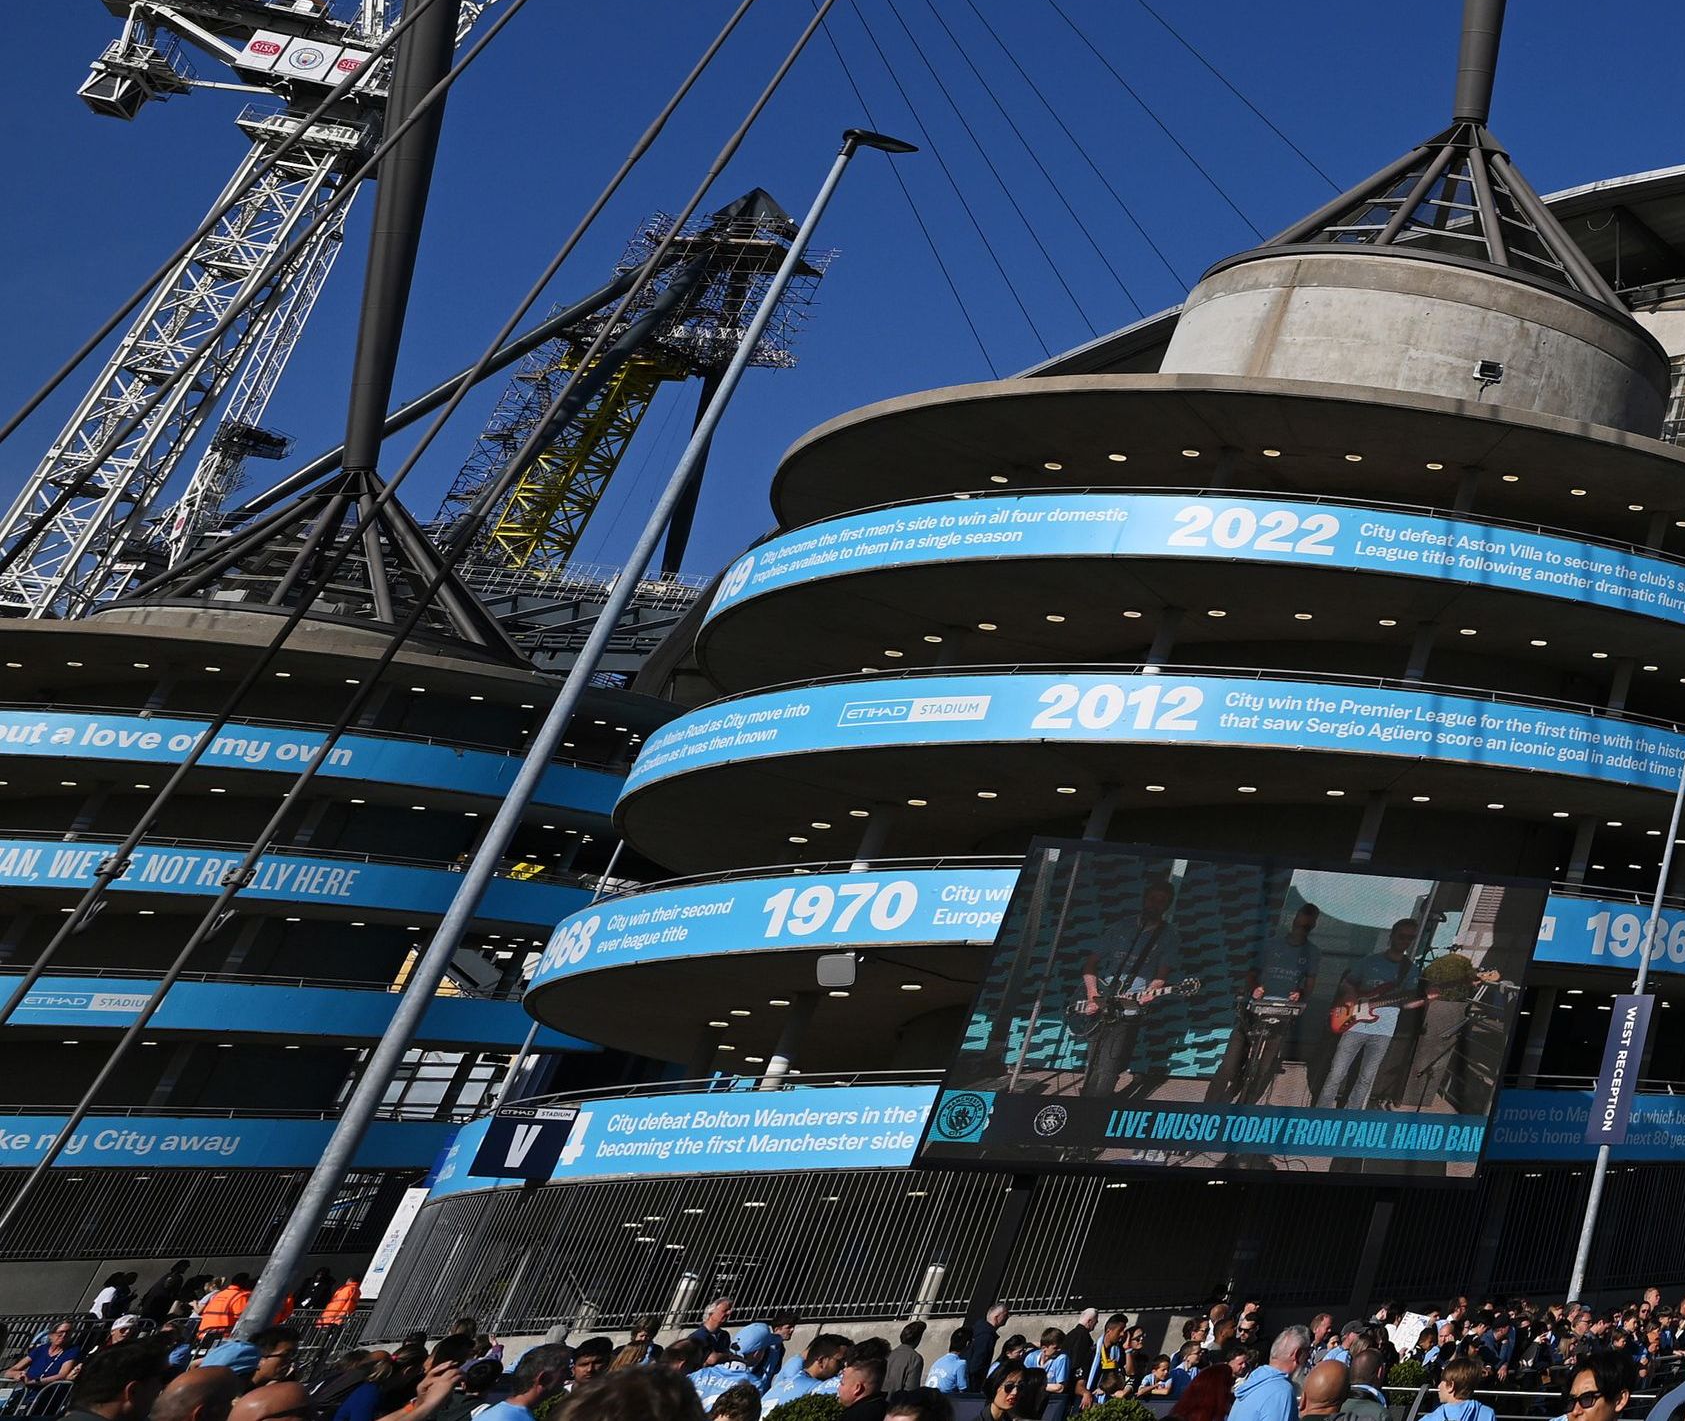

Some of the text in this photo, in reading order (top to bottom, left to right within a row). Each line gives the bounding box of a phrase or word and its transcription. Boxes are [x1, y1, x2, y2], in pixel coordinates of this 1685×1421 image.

[253, 42, 277, 54] SISK
[1166, 505, 1341, 556] 2022
[1355, 541, 1418, 561] League
[1422, 550, 1455, 565] title
[1459, 555, 1532, 580] following
[1534, 570, 1593, 588] another
[1595, 579, 1655, 602] dramatic
[1360, 523, 1396, 542] City
[1399, 528, 1454, 546] defeat
[1456, 536, 1505, 554] Aston
[1510, 544, 1542, 565] Villa
[1546, 551, 1561, 564] to
[1564, 557, 1612, 574] secure
[1615, 565, 1637, 580] the
[1640, 572, 1674, 589] club's
[847, 701, 980, 717] ETIHAD STADIUM
[1031, 684, 1205, 730] 2012
[1226, 692, 1656, 754] City win the Premier League for the first time with the
[50, 727, 76, 745] a
[80, 724, 162, 749] love
[210, 738, 271, 762] my
[139, 854, 360, 896] NOT RELLY HERE
[608, 898, 734, 931] City win their second
[762, 880, 918, 938] 1970
[620, 926, 688, 950] league title
[24, 995, 87, 1007] ETIHAD
[1601, 1006, 1638, 1132] WEST RECEPTION
[501, 1109, 535, 1117] ETIHAD
[608, 1106, 917, 1134] City defeat Bolton Wanderers in the
[1106, 1110, 1148, 1138] LIVE
[1152, 1112, 1222, 1142] MUSIC
[1224, 1116, 1284, 1144] TODAY
[1286, 1118, 1341, 1146] FROM
[1344, 1122, 1388, 1148] PAUL
[1392, 1122, 1441, 1150] HAND
[98, 1130, 240, 1155] City away
[504, 1124, 543, 1167] V
[596, 1132, 916, 1159] becoming the first Manchester side
